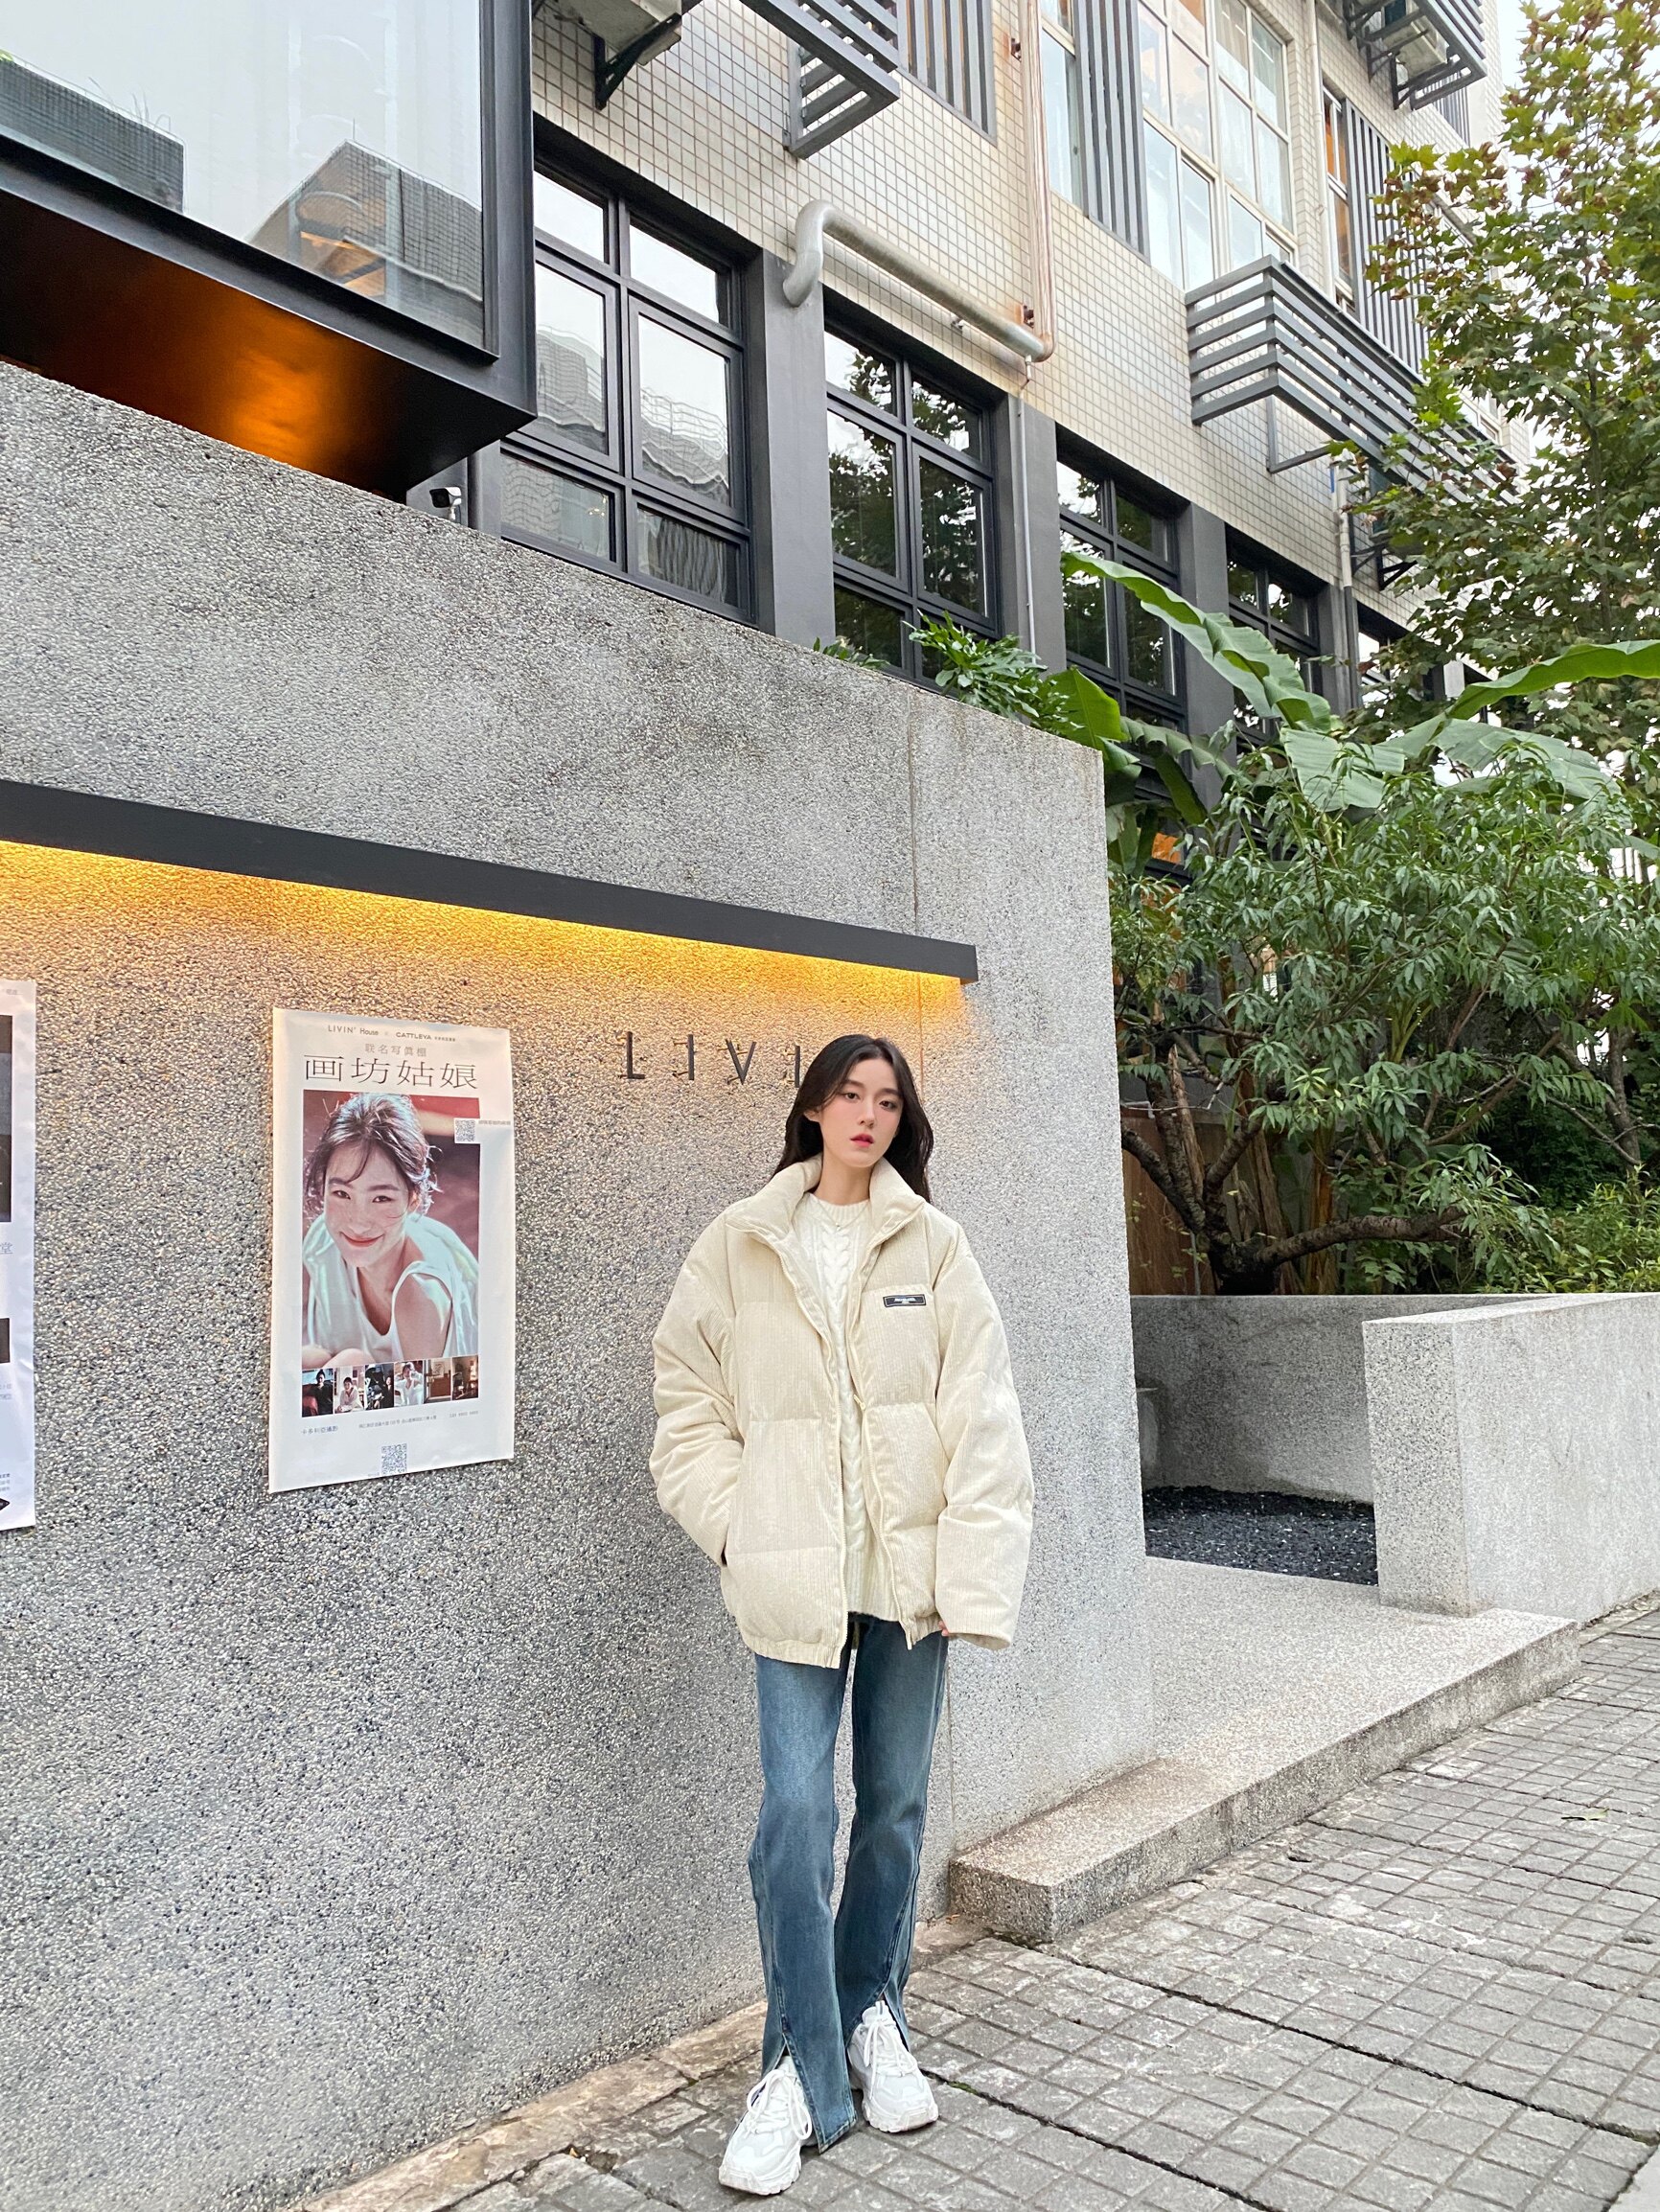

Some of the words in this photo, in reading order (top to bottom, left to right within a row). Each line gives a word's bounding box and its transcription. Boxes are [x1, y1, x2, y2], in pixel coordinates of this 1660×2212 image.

[359, 1027, 380, 1036] House
[395, 1031, 432, 1041] CATTLEYA
[303, 1054, 478, 1090] 画坊姑娘
